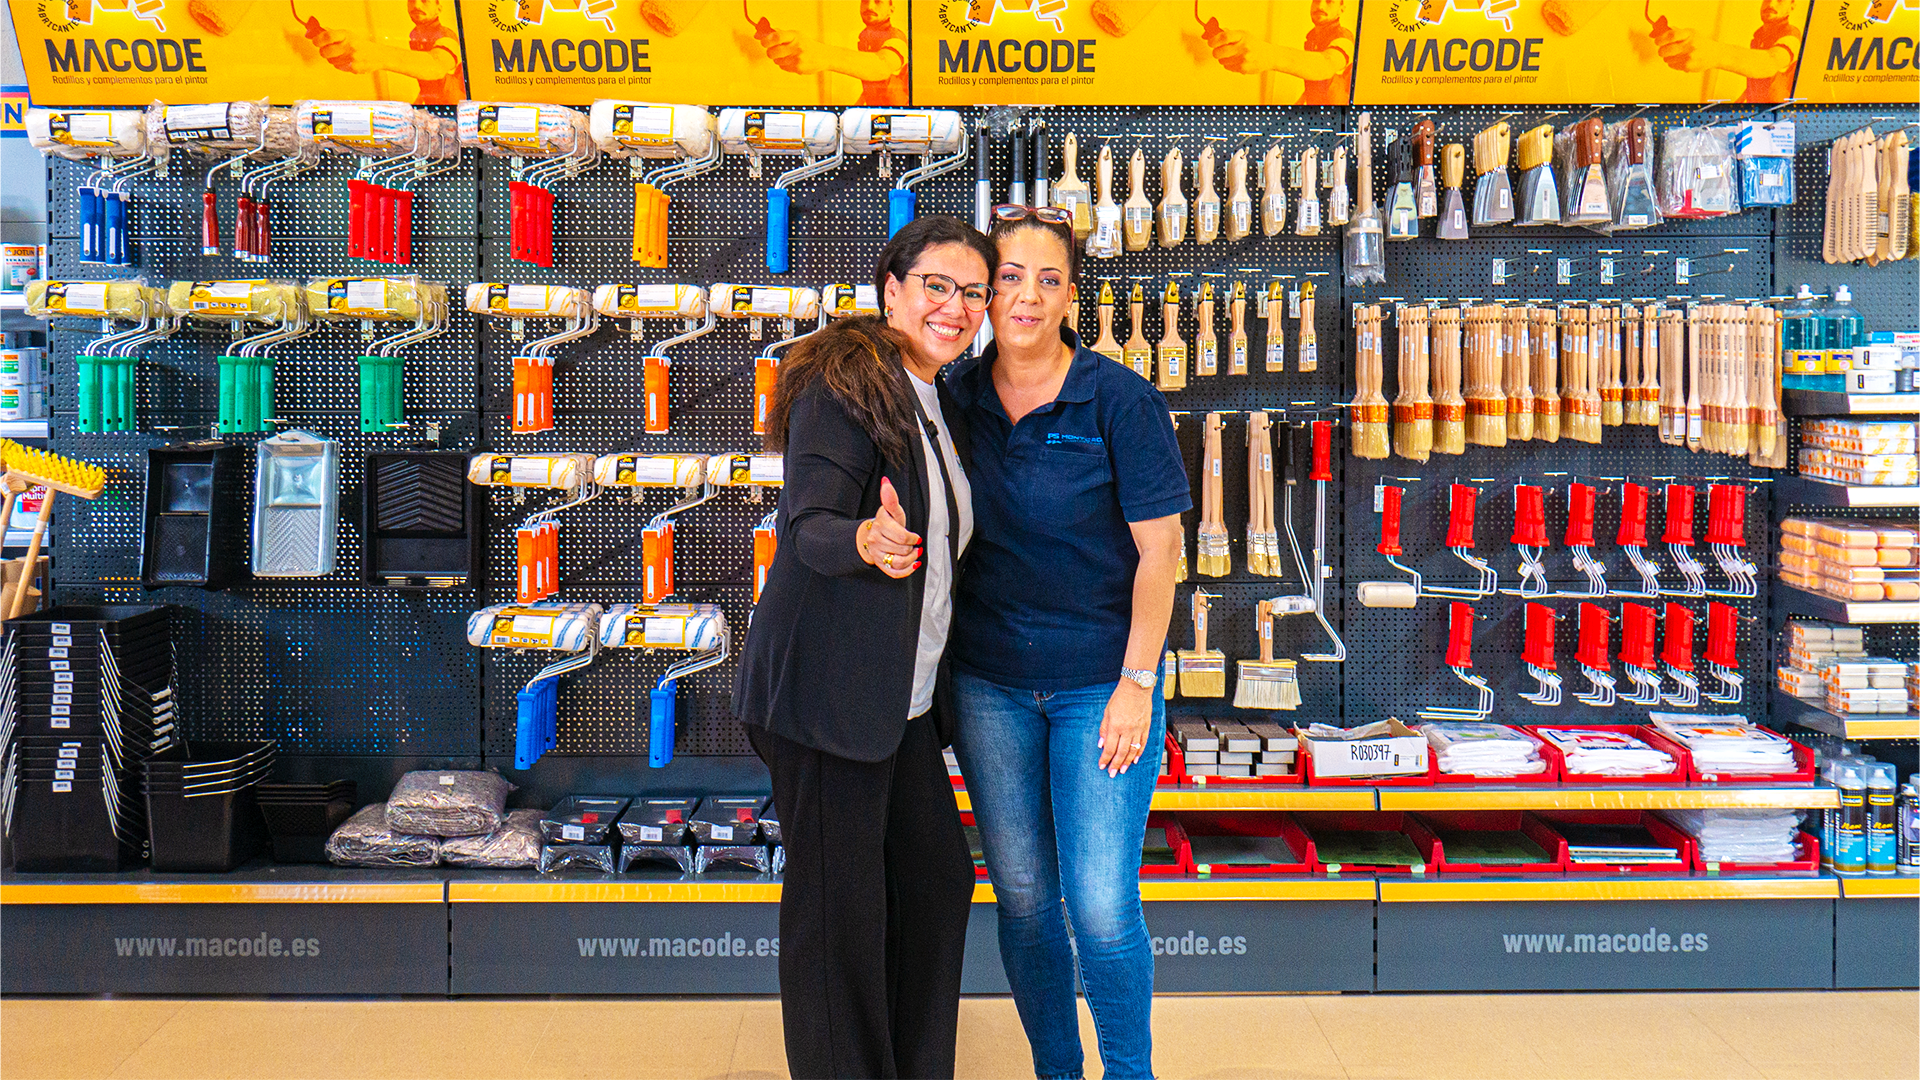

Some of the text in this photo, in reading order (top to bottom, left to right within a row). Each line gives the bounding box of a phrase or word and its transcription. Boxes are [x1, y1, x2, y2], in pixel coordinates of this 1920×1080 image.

[37, 3, 80, 33] FABRICANTES
[488, 3, 530, 33] FABRICANTES
[939, 3, 980, 34] FABRICANTES
[1389, 3, 1430, 33] FABRICANTES
[1838, 1, 1879, 31] FABRICANTES
[44, 38, 207, 73] MACODE
[491, 39, 652, 73] MACODE
[938, 39, 1097, 73] MACODE
[1383, 38, 1544, 72] MACODE
[52, 76, 208, 86] Rodillos y complementos para el pintor
[495, 76, 652, 86] Rodillos y complementos para el pintor
[938, 76, 1095, 86] Rodillos y complementos para el pintor
[1381, 75, 1538, 86] Rodillos y complementos para el pintor
[1823, 74, 1854, 82] Rodillos
[1351, 744, 1391, 761] R030397
[114, 931, 321, 957] www.macode.es
[577, 931, 780, 957] www.macode.es
[1151, 930, 1248, 956] code.es
[1502, 927, 1709, 953] www.macode.es
